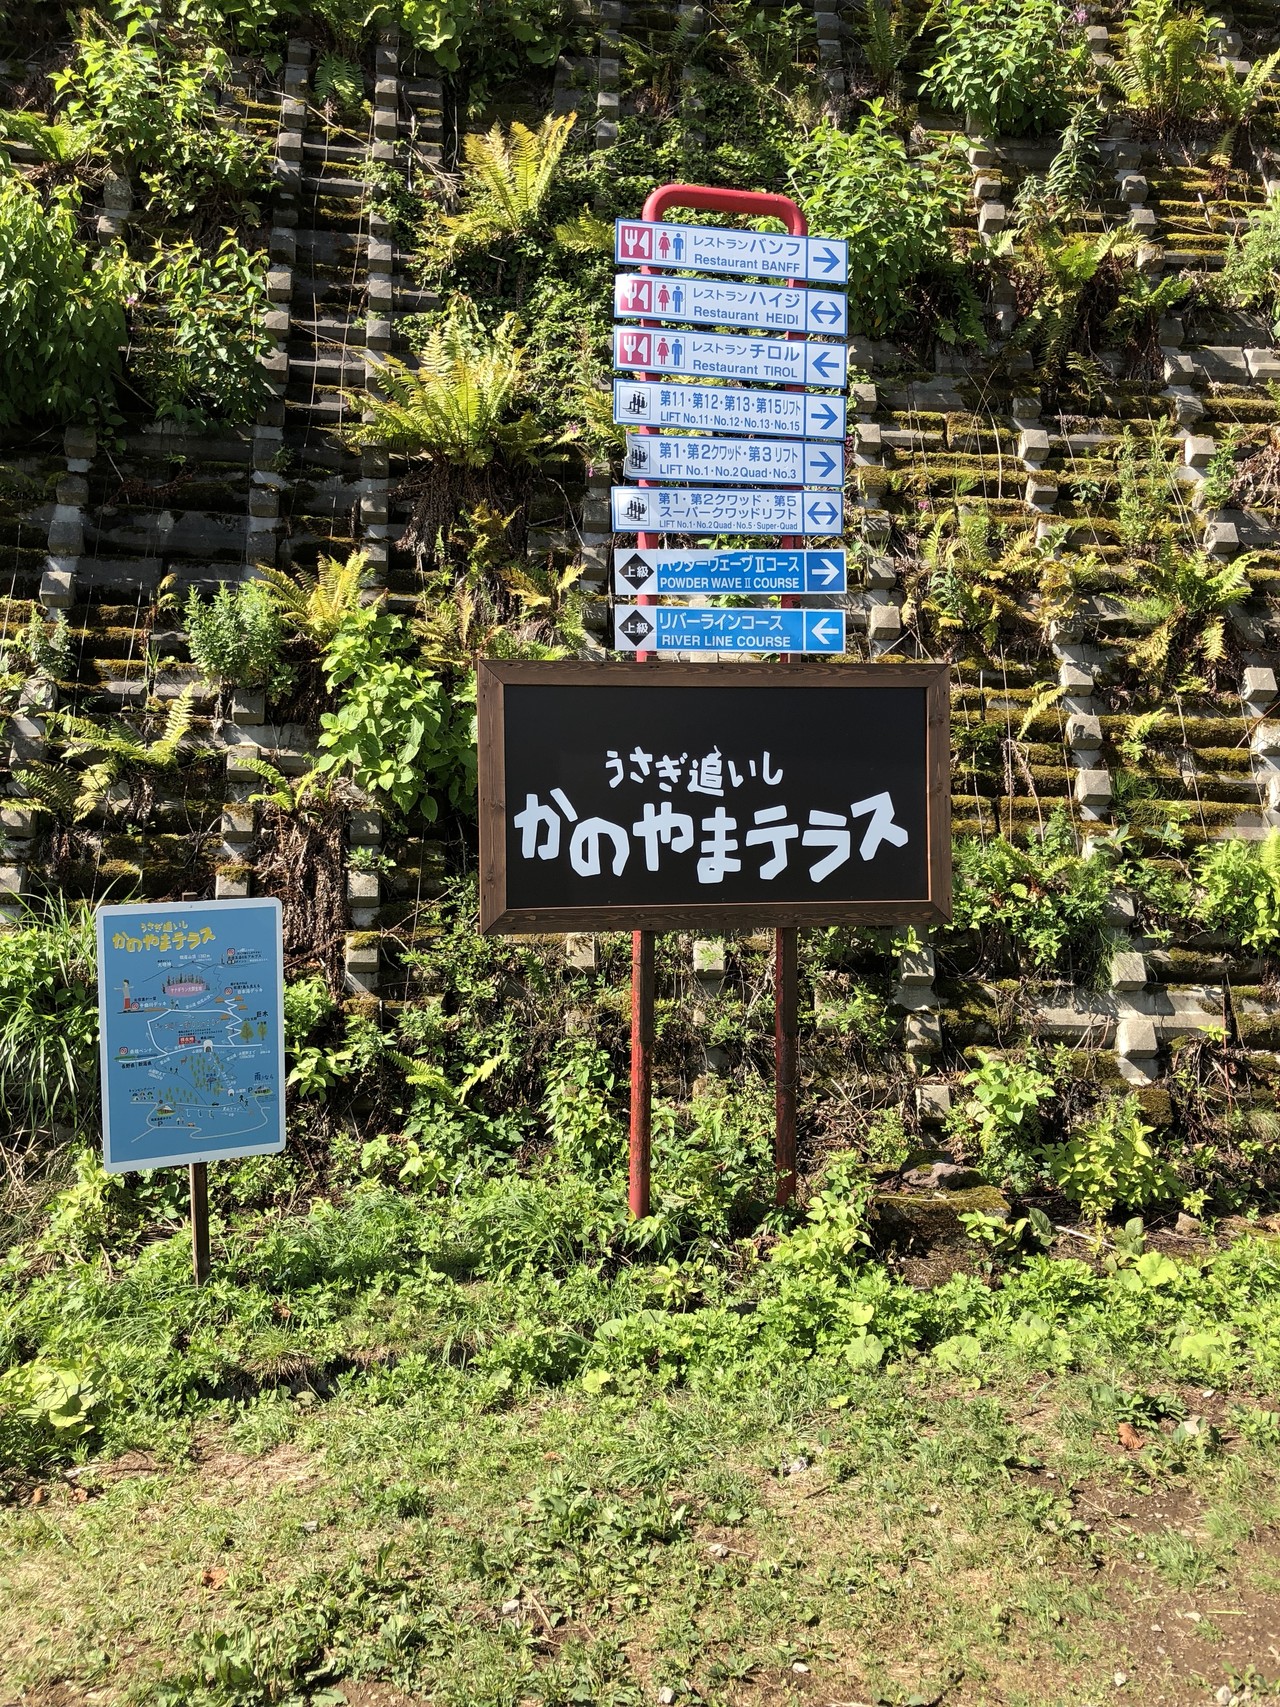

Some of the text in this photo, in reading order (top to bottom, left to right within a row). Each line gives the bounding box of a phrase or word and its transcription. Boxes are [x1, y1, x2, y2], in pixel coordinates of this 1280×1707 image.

[694, 254, 800, 273] Restaurant BANFF
[694, 306, 799, 325] Restaurant HEIDI
[693, 360, 798, 378] Restaurant TIROL
[660, 411, 681, 423] LIFT
[659, 464, 683, 475] LIFT
[659, 506, 798, 520] スーパークワッドリフト
[659, 520, 675, 528] LIFT
[624, 566, 649, 578] 上級
[660, 577, 709, 589] POWDER
[711, 577, 743, 589] WAVE
[753, 577, 799, 589] COURSE
[659, 612, 783, 631] リバーラインコース
[623, 622, 648, 635] 上級
[662, 635, 791, 647] RIVER LINE COURSE
[605, 745, 784, 797] うさぎ追いし
[513, 787, 909, 884] かのやまテラス
[140, 920, 189, 933] うさぎ追いし
[112, 926, 216, 953] かのやまテラス
